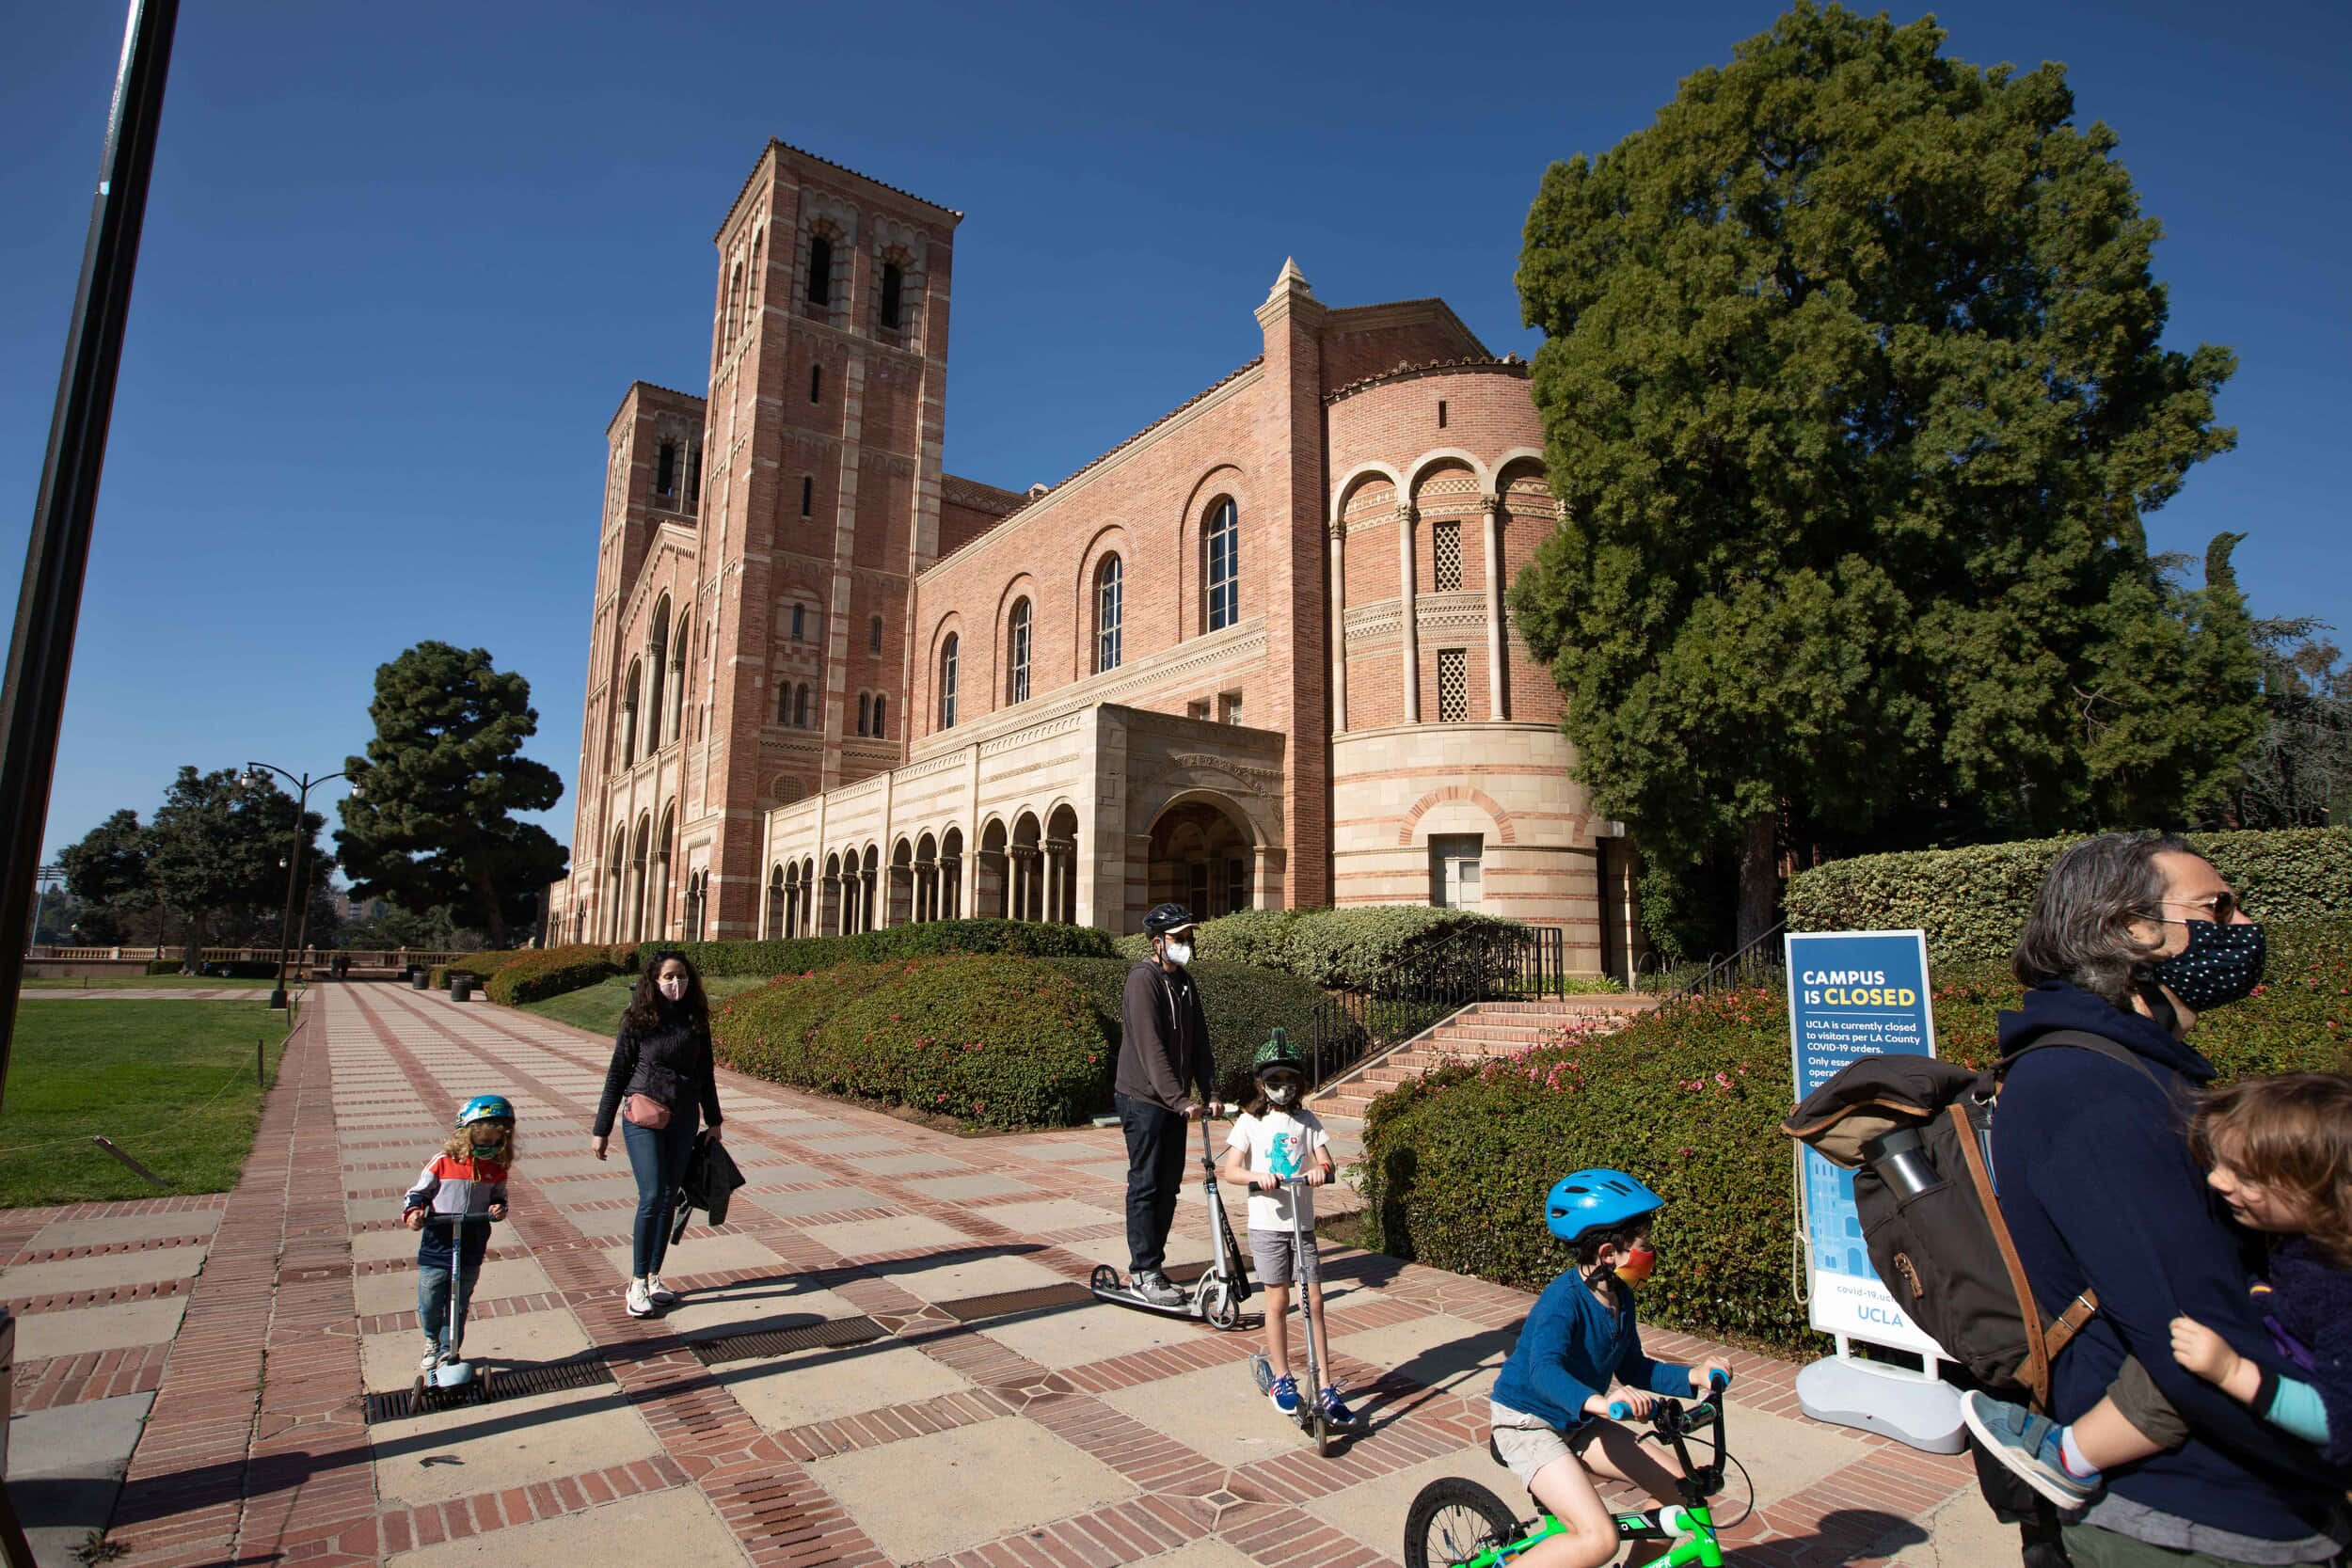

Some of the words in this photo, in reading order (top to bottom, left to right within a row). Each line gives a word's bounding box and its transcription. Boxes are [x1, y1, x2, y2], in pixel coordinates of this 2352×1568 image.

[1803, 971, 1885, 985] CAMPUS
[1804, 990, 1820, 1005] IS
[1824, 989, 1915, 1006] CLOSED
[1805, 1021, 1830, 1029] UCLA
[1832, 1021, 1839, 1029] is
[1841, 1022, 1883, 1032] currently
[1884, 1022, 1916, 1032] closed
[1818, 1032, 1851, 1040] visitors
[1851, 1035, 1867, 1043] per
[1870, 1034, 1883, 1042] LA
[1884, 1034, 1920, 1045] County
[1807, 1042, 1849, 1052] COVID-19
[1851, 1044, 1883, 1053] orders.
[1808, 1056, 1829, 1068] Only
[1301, 1283, 1311, 1322] Razor
[1858, 1305, 1903, 1327] UCLA
